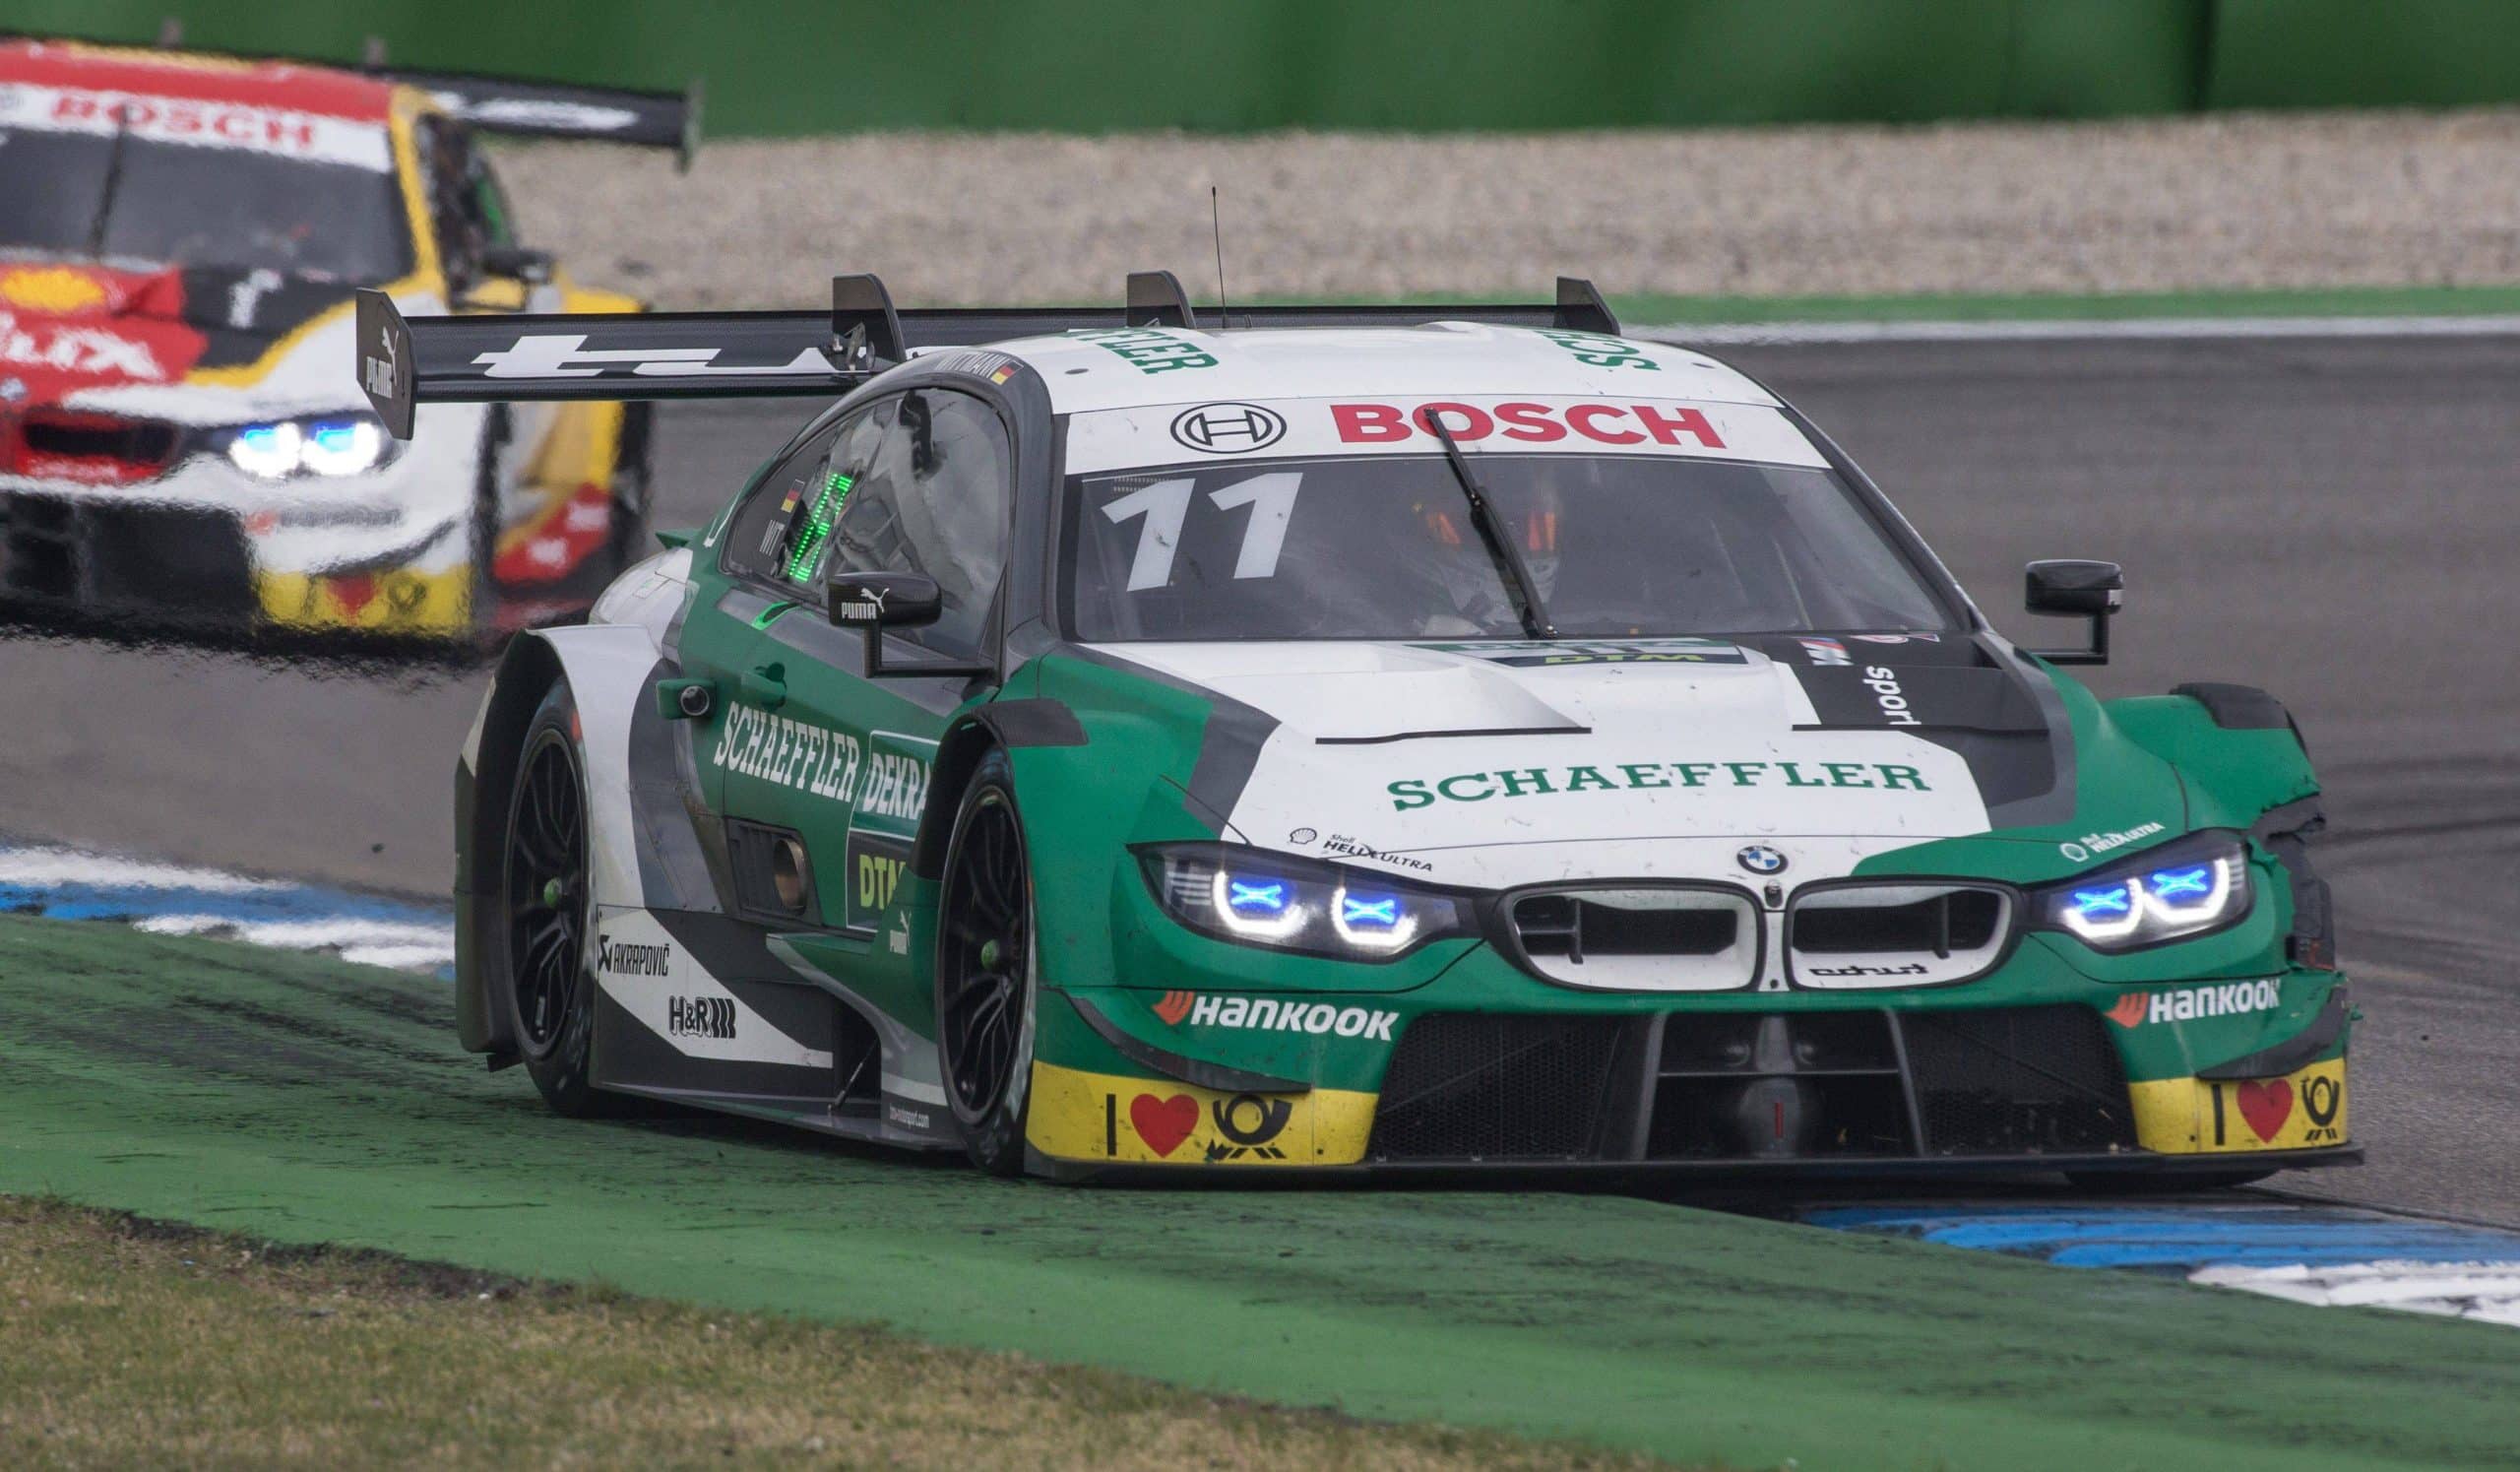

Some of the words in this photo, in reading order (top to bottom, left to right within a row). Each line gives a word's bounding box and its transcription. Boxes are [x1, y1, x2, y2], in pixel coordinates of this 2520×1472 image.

[51, 96, 314, 145] BOSCH
[1329, 402, 1728, 449] BOSCH
[1101, 473, 1303, 592] 11
[842, 602, 877, 619] PUMA
[713, 701, 860, 802] SCHAEFFLER
[1386, 761, 1933, 811] SCHAEFFLER
[1378, 852, 1433, 872] ULTRA
